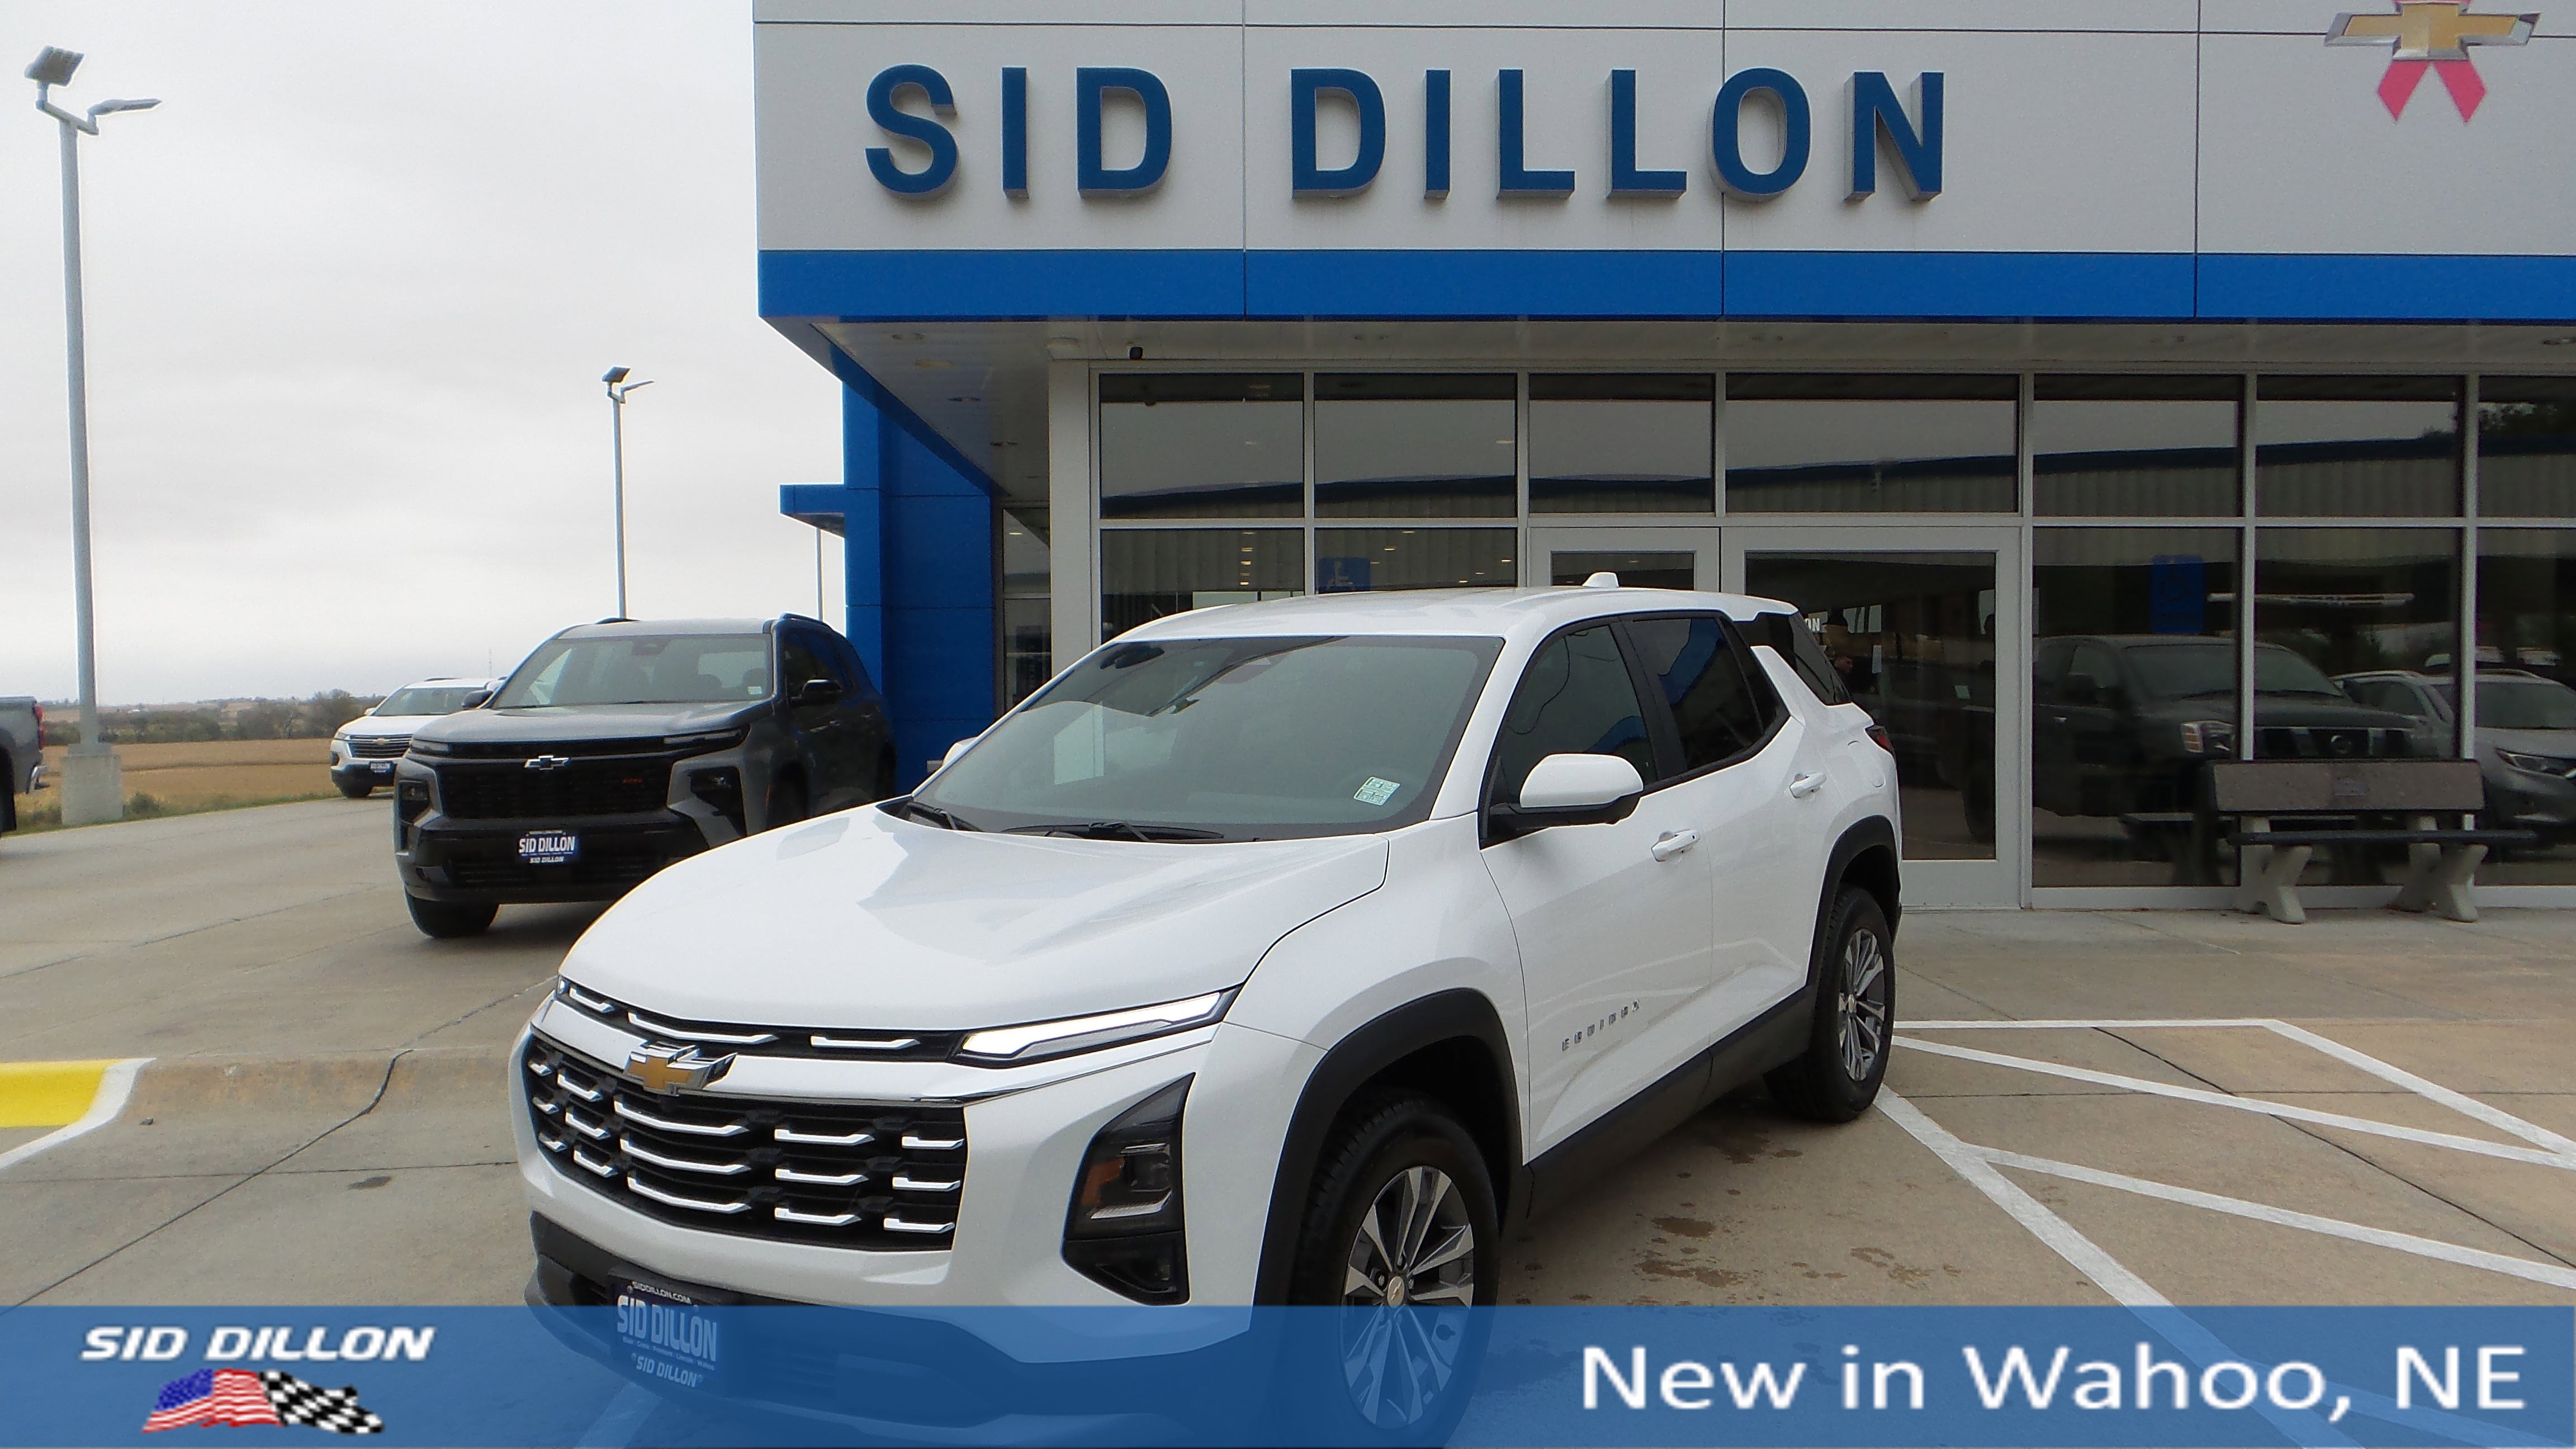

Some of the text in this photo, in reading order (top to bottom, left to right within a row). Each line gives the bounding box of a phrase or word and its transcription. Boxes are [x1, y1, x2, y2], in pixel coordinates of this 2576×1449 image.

[865, 63, 1944, 201] SID DILLON
[519, 836, 575, 853] SID DILLON
[1562, 999, 1640, 1051] EQUINOX
[617, 1294, 717, 1362] SID DILLON
[636, 1356, 697, 1388] SID DILLON
